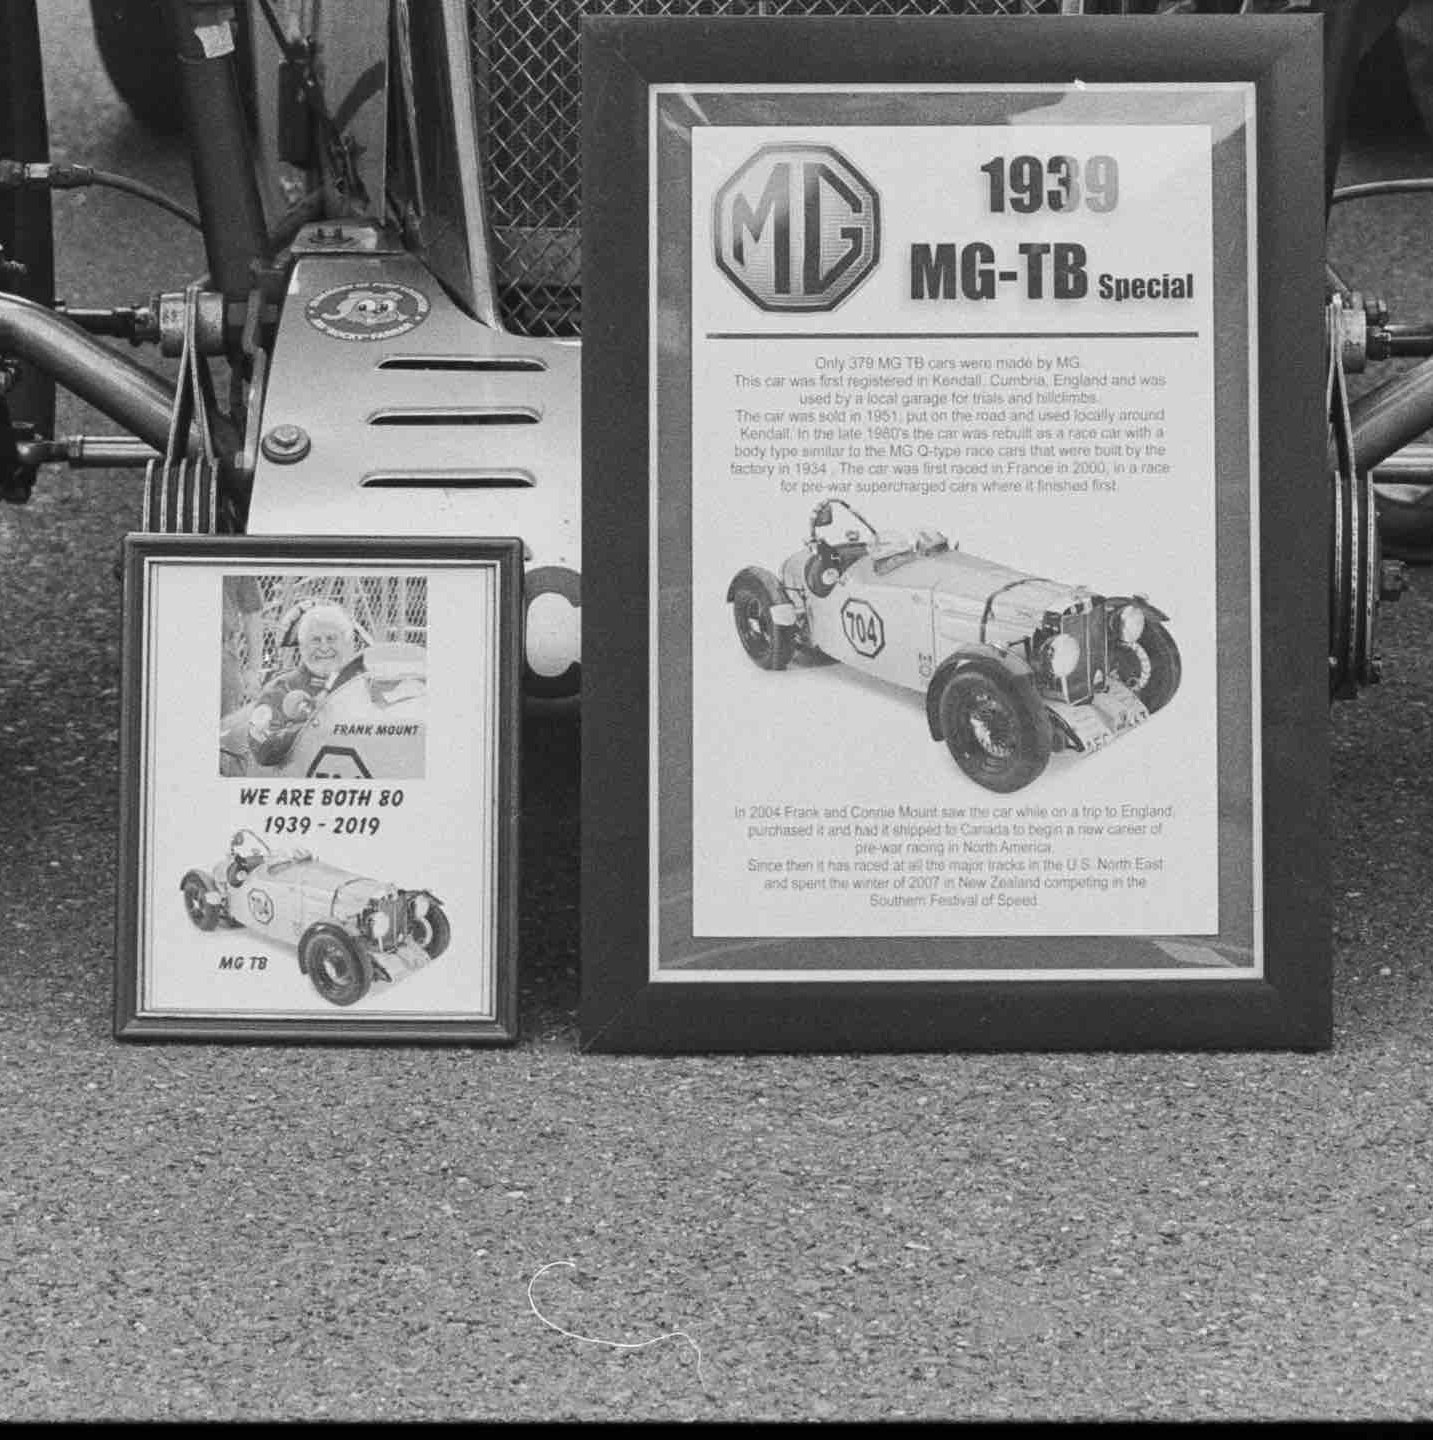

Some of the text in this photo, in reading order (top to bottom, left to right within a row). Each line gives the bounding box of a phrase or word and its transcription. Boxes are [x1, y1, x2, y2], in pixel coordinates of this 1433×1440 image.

[980, 154, 1120, 215] 1939
[729, 160, 867, 297] MG
[909, 240, 1195, 303] MG-TB Special
[815, 356, 845, 372] Only
[877, 356, 903, 369] MG
[906, 356, 924, 369] TB
[927, 359, 956, 369] cars
[959, 359, 992, 369] were
[995, 356, 1033, 369] made
[1036, 356, 1052, 372] by
[735, 373, 761, 387] This
[764, 376, 785, 387] car
[788, 376, 816, 387] was
[819, 373, 843, 387] first
[846, 373, 913, 390] registered
[1052, 373, 1107, 390] England
[1110, 373, 1136, 387] and
[1139, 376, 1167, 387] was
[799, 391, 1032, 408] used by local garage for trials and
[736, 409, 1165, 425] The car was sold put on the road and used locally around
[812, 426, 835, 440] the
[838, 426, 863, 440] late
[912, 426, 934, 440] the
[937, 429, 958, 440] car
[961, 429, 988, 440] was
[991, 426, 1032, 440] rebuilt
[1035, 429, 1052, 440] as
[1067, 429, 1097, 440] race
[1100, 429, 1121, 440] car
[1124, 426, 1151, 440] with
[734, 443, 766, 460] body
[769, 443, 798, 460] type
[801, 443, 845, 457] similar
[864, 443, 886, 457] the
[889, 443, 913, 457] MG
[964, 446, 994, 457] race
[997, 446, 1026, 457] cars
[1029, 443, 1055, 457] that
[1058, 446, 1091, 457] were
[1094, 443, 1122, 457] built
[1125, 443, 1141, 460] by
[1144, 443, 1167, 457] the
[730, 461, 1170, 477] factory 1934 The car was first raced France race
[780, 479, 798, 492] for
[855, 479, 945, 495] supercharged
[948, 482, 977, 492] cars
[980, 479, 1022, 492] where
[1036, 479, 1088, 492] finished
[846, 610, 878, 647] 704
[333, 724, 419, 737] FRANK MOUNT
[239, 788, 404, 809] WE ARE BOTH 80
[749, 805, 1102, 821] 2004 Frank and Connie Mount saw the car while on trip
[264, 816, 311, 836] 1939
[333, 816, 380, 837] 2019
[747, 822, 1147, 839] purchased and had shipped Canada begin new career
[906, 840, 944, 856] racing
[962, 840, 997, 853] North
[748, 858, 1163, 874] Since then has raced all the major tracks the North East
[764, 875, 787, 889] and
[790, 875, 826, 892] spent
[829, 875, 849, 889] the
[852, 875, 889, 889] winter
[908, 875, 940, 889] 2007
[958, 875, 987, 889] New
[989, 875, 1041, 889] Zealand
[1043, 875, 1109, 892] competing
[1126, 875, 1147, 889] the
[870, 893, 927, 907] Southern
[929, 893, 978, 907] Festival
[218, 956, 268, 971] MG TB
